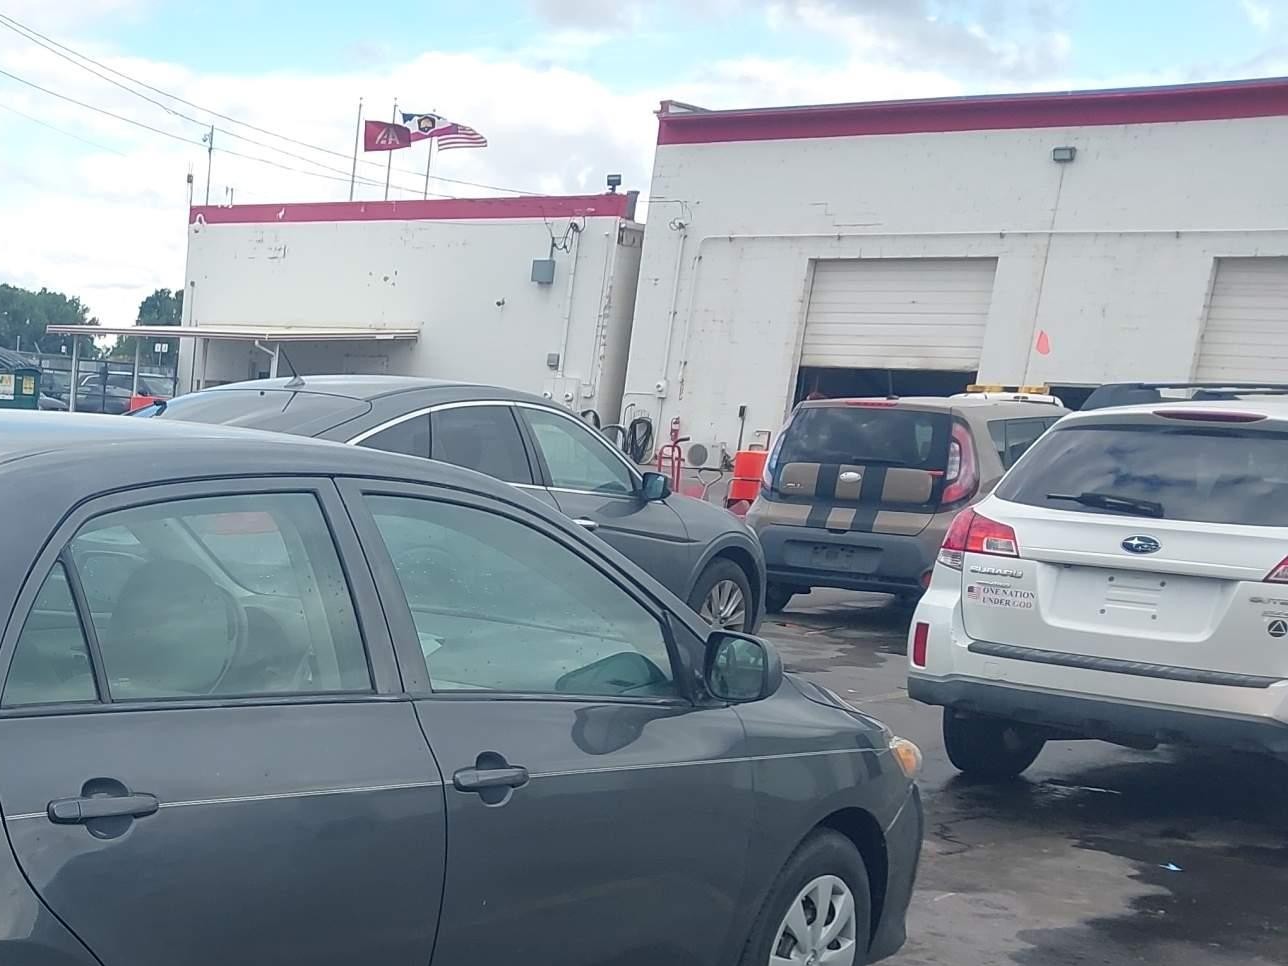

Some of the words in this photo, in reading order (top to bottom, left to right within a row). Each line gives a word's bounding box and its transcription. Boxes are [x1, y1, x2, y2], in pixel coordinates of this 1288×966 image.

[982, 587, 1001, 596] ONE
[1002, 589, 1035, 599] NATION
[982, 597, 1010, 607] UNDER
[1012, 600, 1032, 608] GOD
